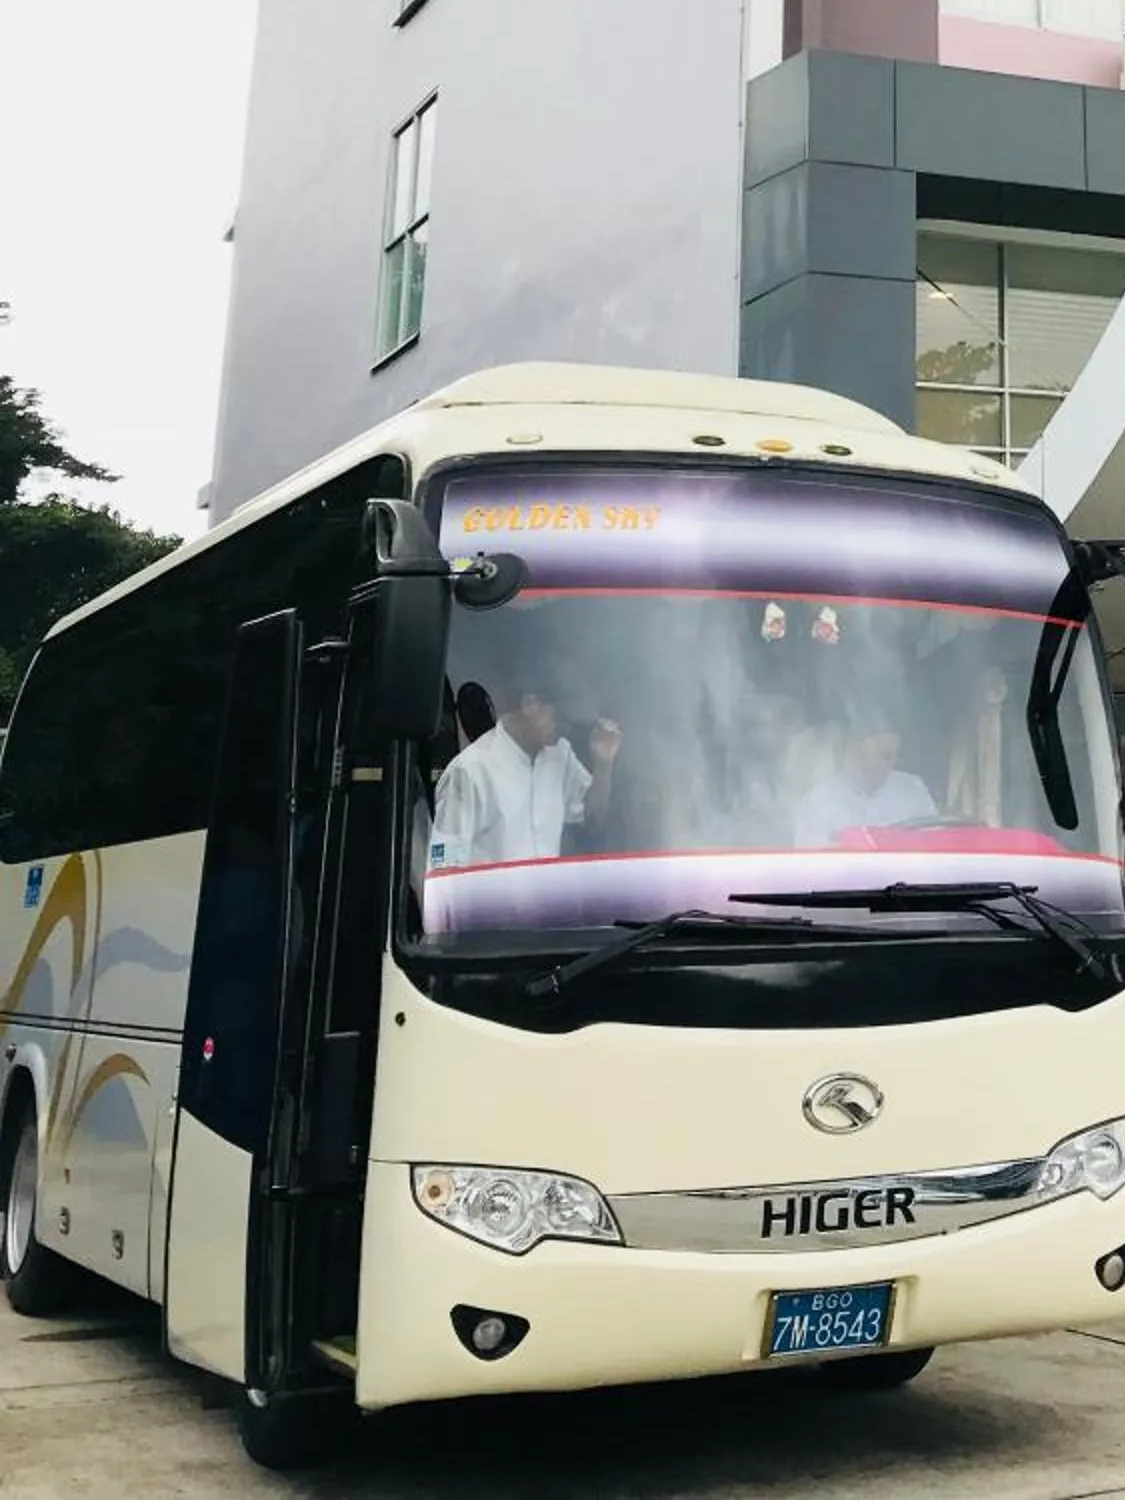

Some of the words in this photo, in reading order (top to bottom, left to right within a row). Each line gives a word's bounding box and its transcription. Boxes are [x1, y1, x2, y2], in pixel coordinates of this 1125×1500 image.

[463, 501, 592, 533] GOLDEN
[761, 1187, 915, 1238] HIGER
[811, 1292, 853, 1311] BGO
[773, 1308, 881, 1350] 7M-8543
